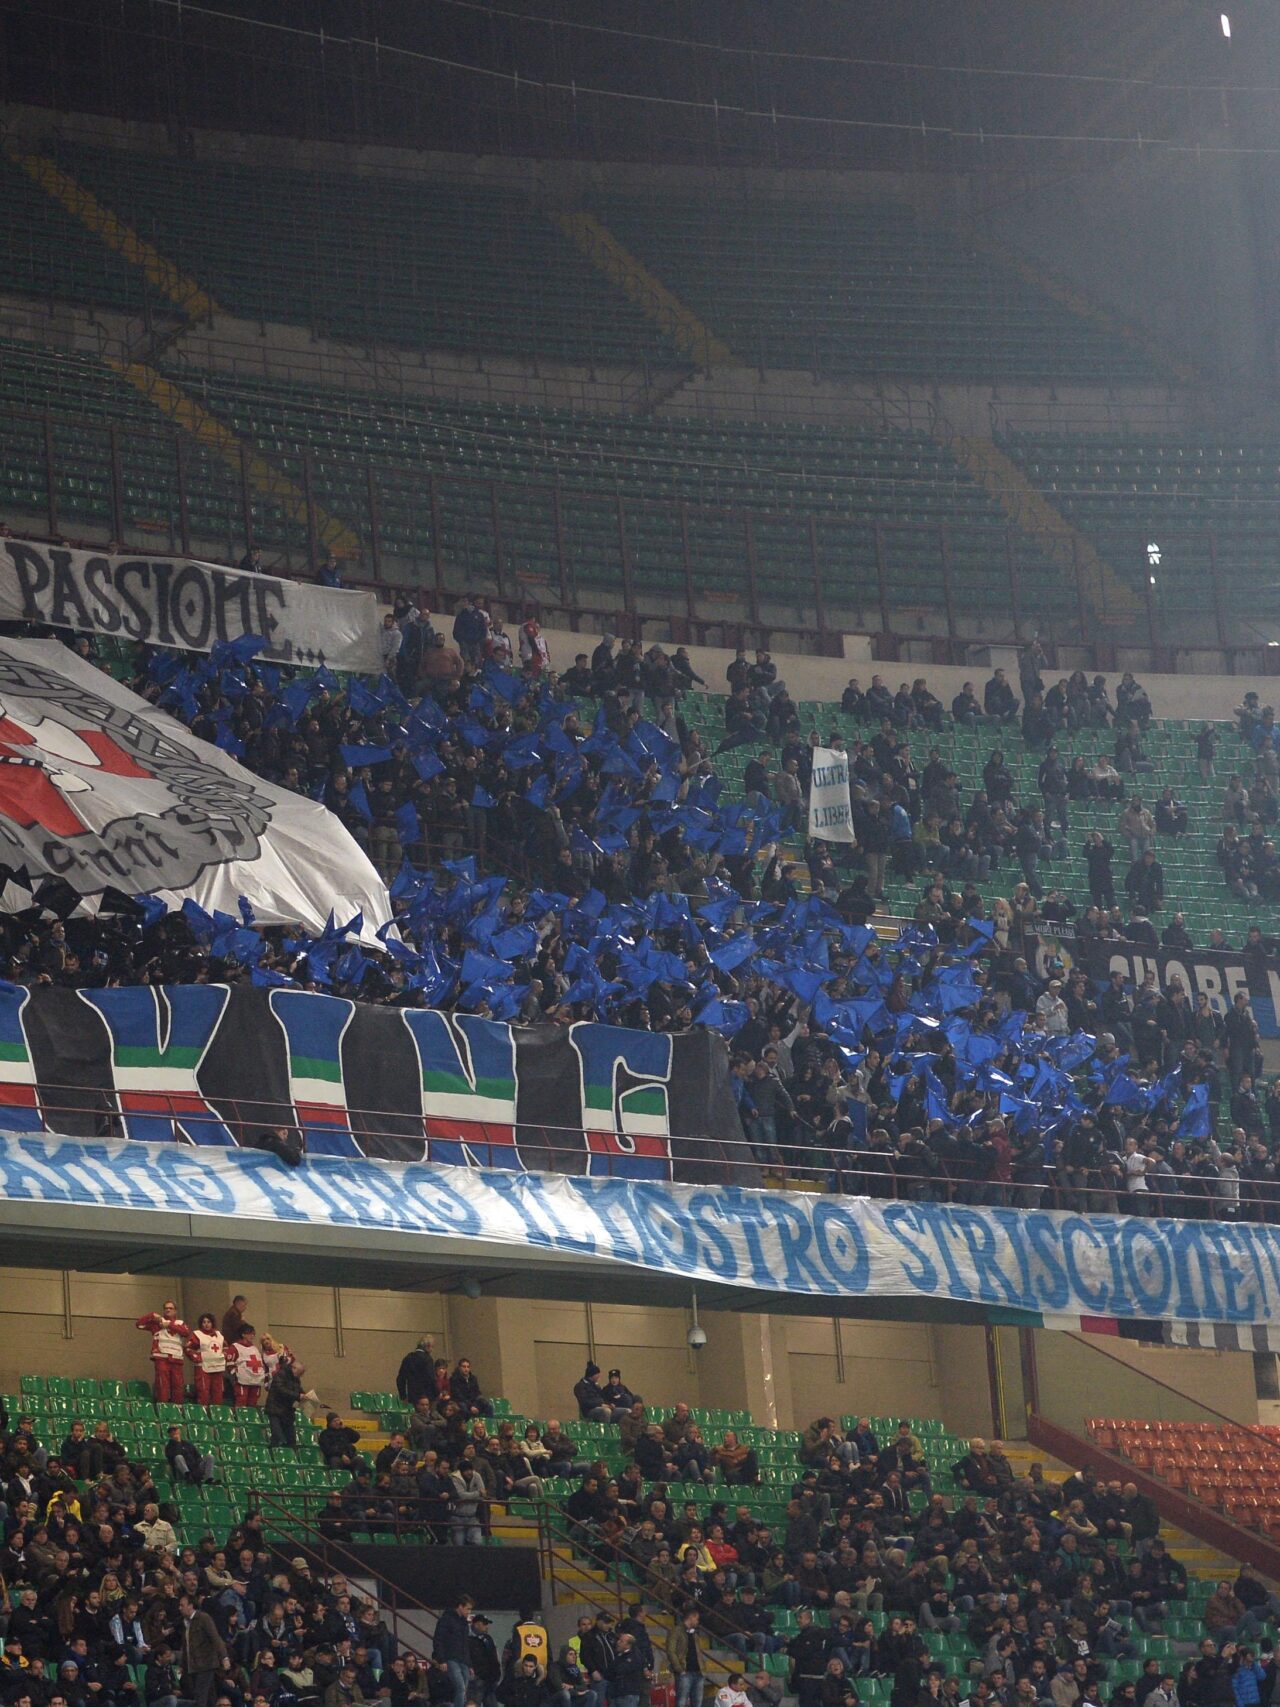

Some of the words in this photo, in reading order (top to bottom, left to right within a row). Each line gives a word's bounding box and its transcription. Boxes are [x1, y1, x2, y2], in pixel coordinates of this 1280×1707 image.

[42, 821, 180, 877] anni
[478, 1170, 597, 1255] IL
[569, 1175, 869, 1294] NOSTRO
